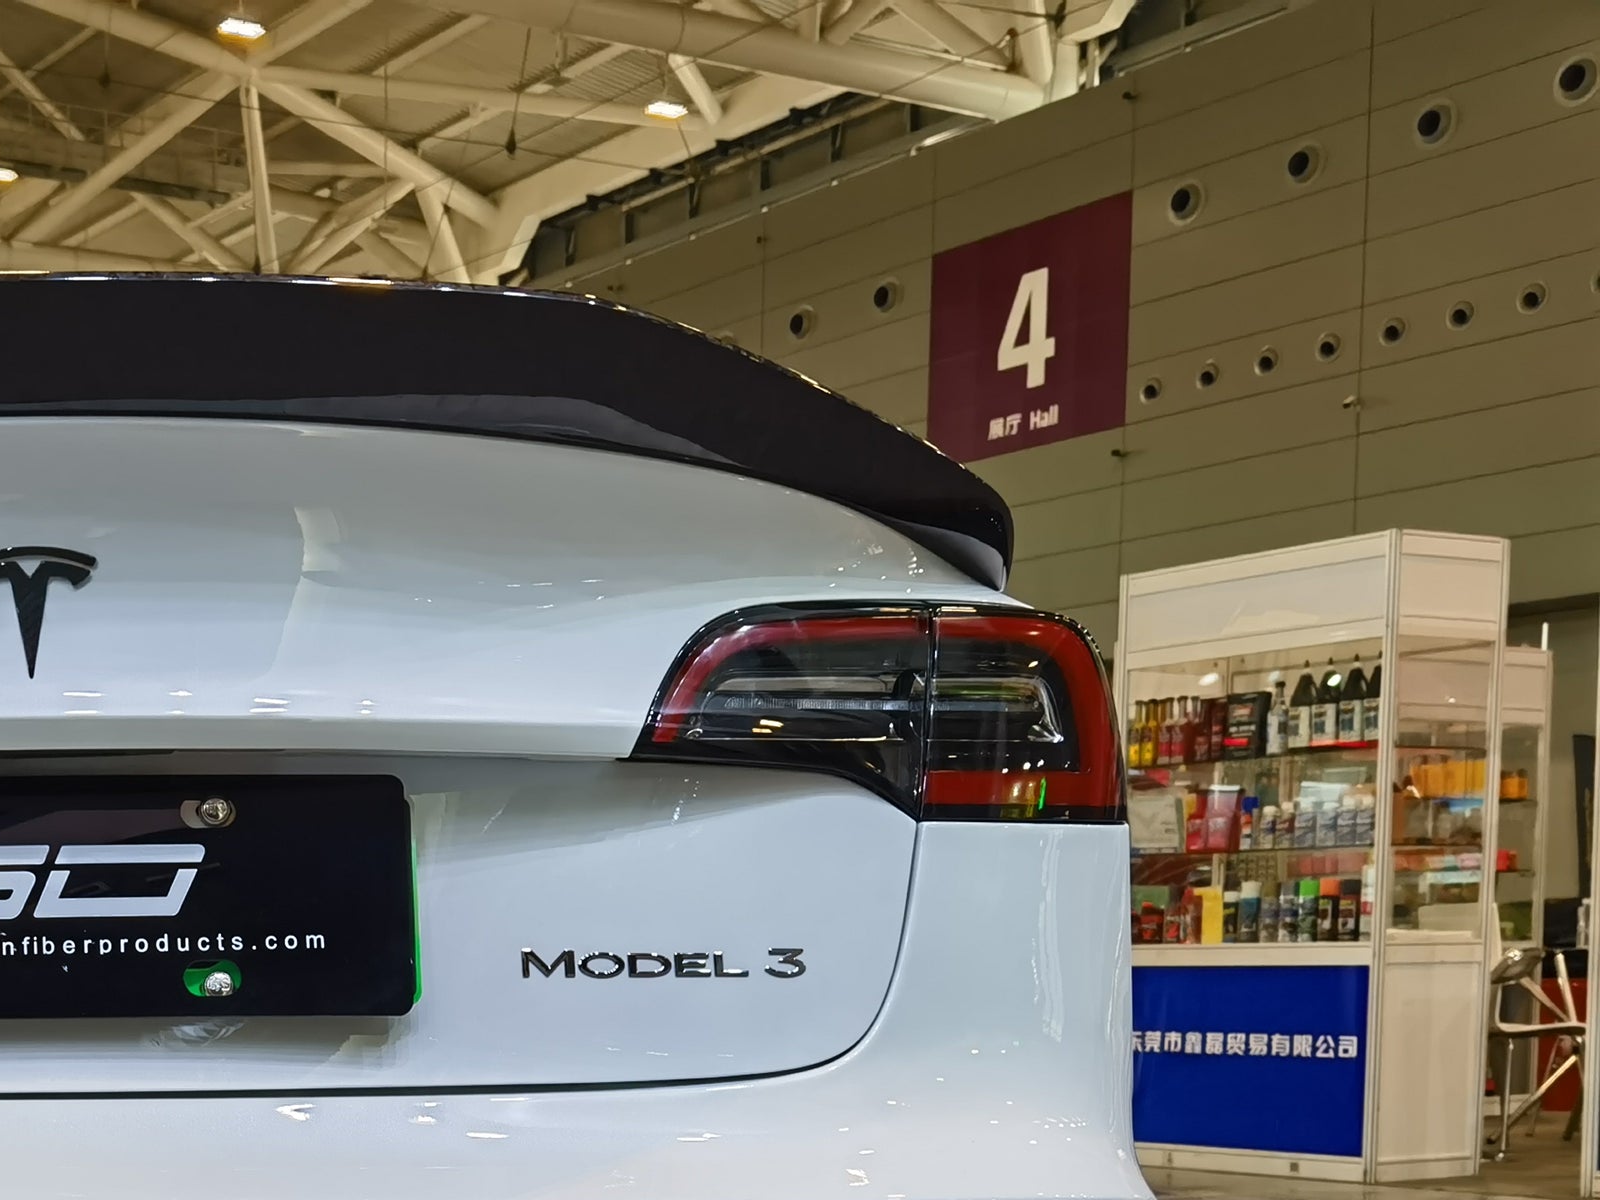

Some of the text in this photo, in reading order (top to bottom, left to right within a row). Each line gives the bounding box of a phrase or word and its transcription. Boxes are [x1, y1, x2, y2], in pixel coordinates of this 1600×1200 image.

[997, 267, 1056, 389] 4
[987, 404, 1059, 441] 展厅 Hall
[521, 947, 807, 979] MODEL 3
